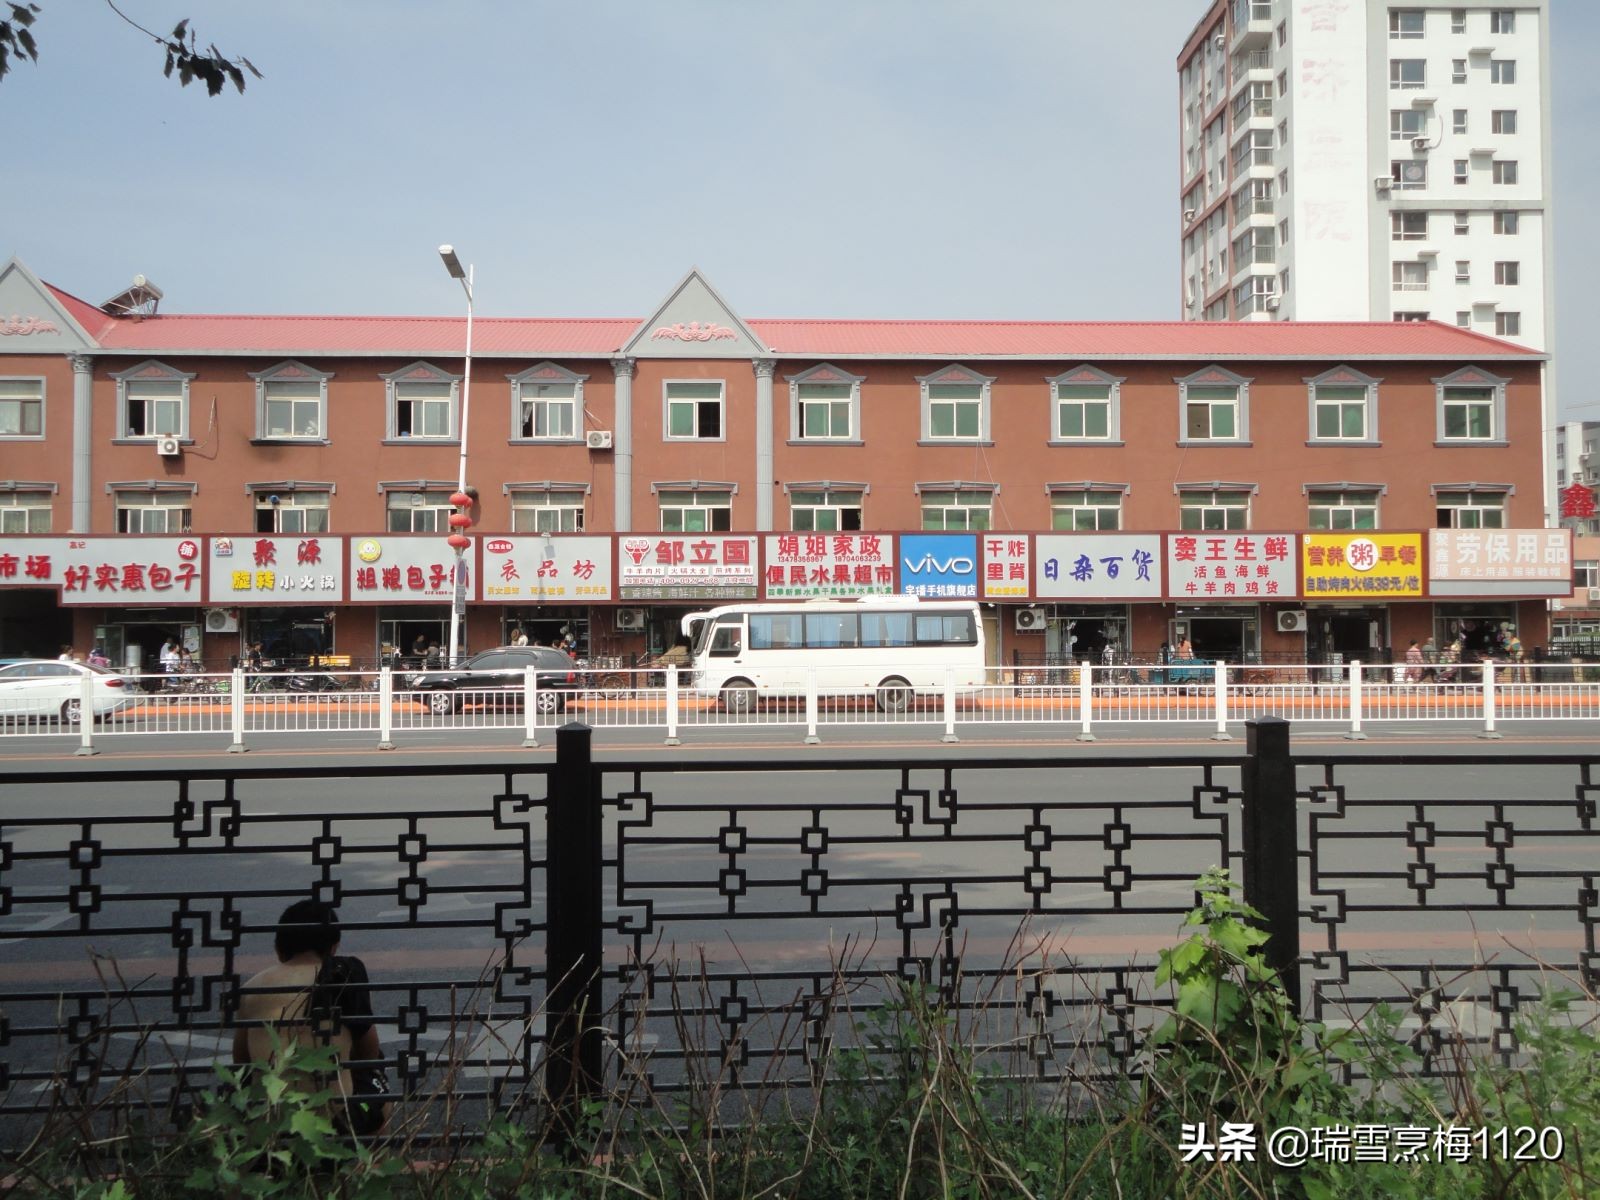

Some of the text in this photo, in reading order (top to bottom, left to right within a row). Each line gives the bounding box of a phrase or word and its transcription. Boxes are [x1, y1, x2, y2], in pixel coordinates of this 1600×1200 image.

[1560, 482, 1596, 519] 鑫
[655, 540, 750, 566] 邹立国
[777, 535, 882, 556] 娟姐家政
[987, 539, 1025, 558] 干炸
[1174, 536, 1289, 562] 窦王生鲜
[1456, 533, 1568, 564] 劳保用品
[500, 559, 596, 582] 衣品坊
[904, 552, 974, 573] vivo
[987, 562, 1025, 581] 里脊
[1044, 549, 1154, 582] 日杂百货
[1194, 564, 1270, 578] 活鱼海鲜
[64, 562, 200, 592] 好实惠包子
[231, 570, 336, 591] 旋转小火锅
[767, 564, 893, 586] 便民水果超市
[1185, 580, 1279, 594] 牛羊肉鸡货
